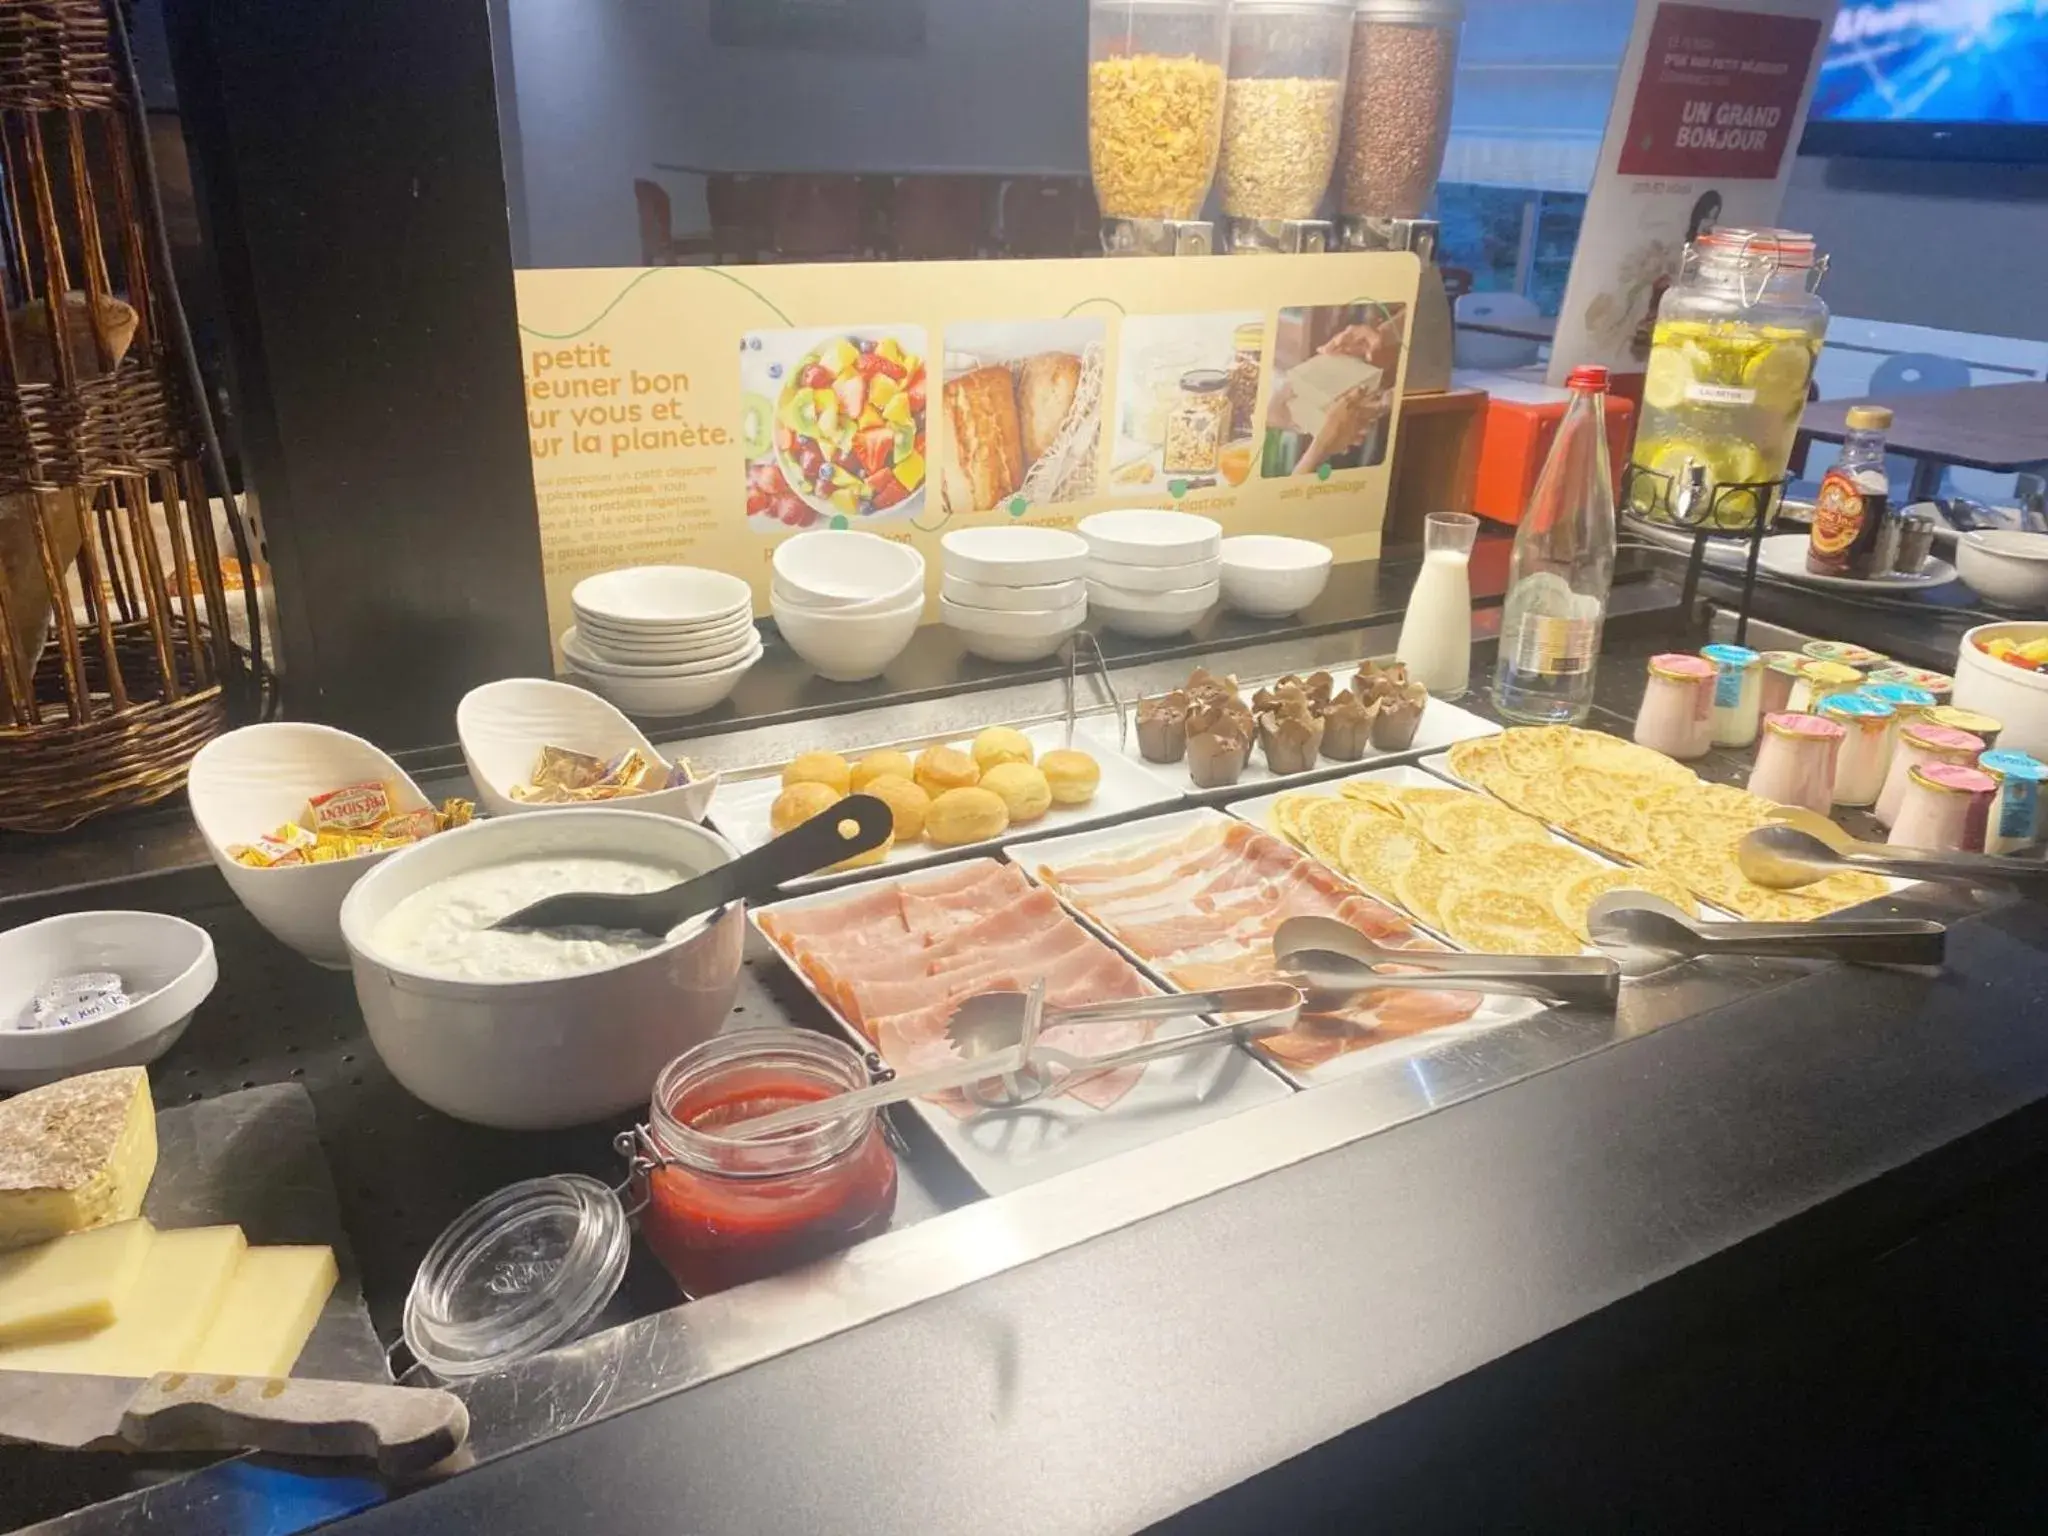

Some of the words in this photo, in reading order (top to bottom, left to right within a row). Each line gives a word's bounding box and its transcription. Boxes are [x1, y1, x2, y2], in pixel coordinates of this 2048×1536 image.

[1682, 100, 1712, 124] UN
[1716, 102, 1781, 128] GRAND
[1675, 126, 1768, 151] BONJOUR
[532, 342, 612, 377] petit
[631, 370, 688, 395] bon
[571, 404, 641, 427] vous
[651, 398, 683, 420] et
[573, 431, 602, 454] la
[612, 422, 734, 458] planète.
